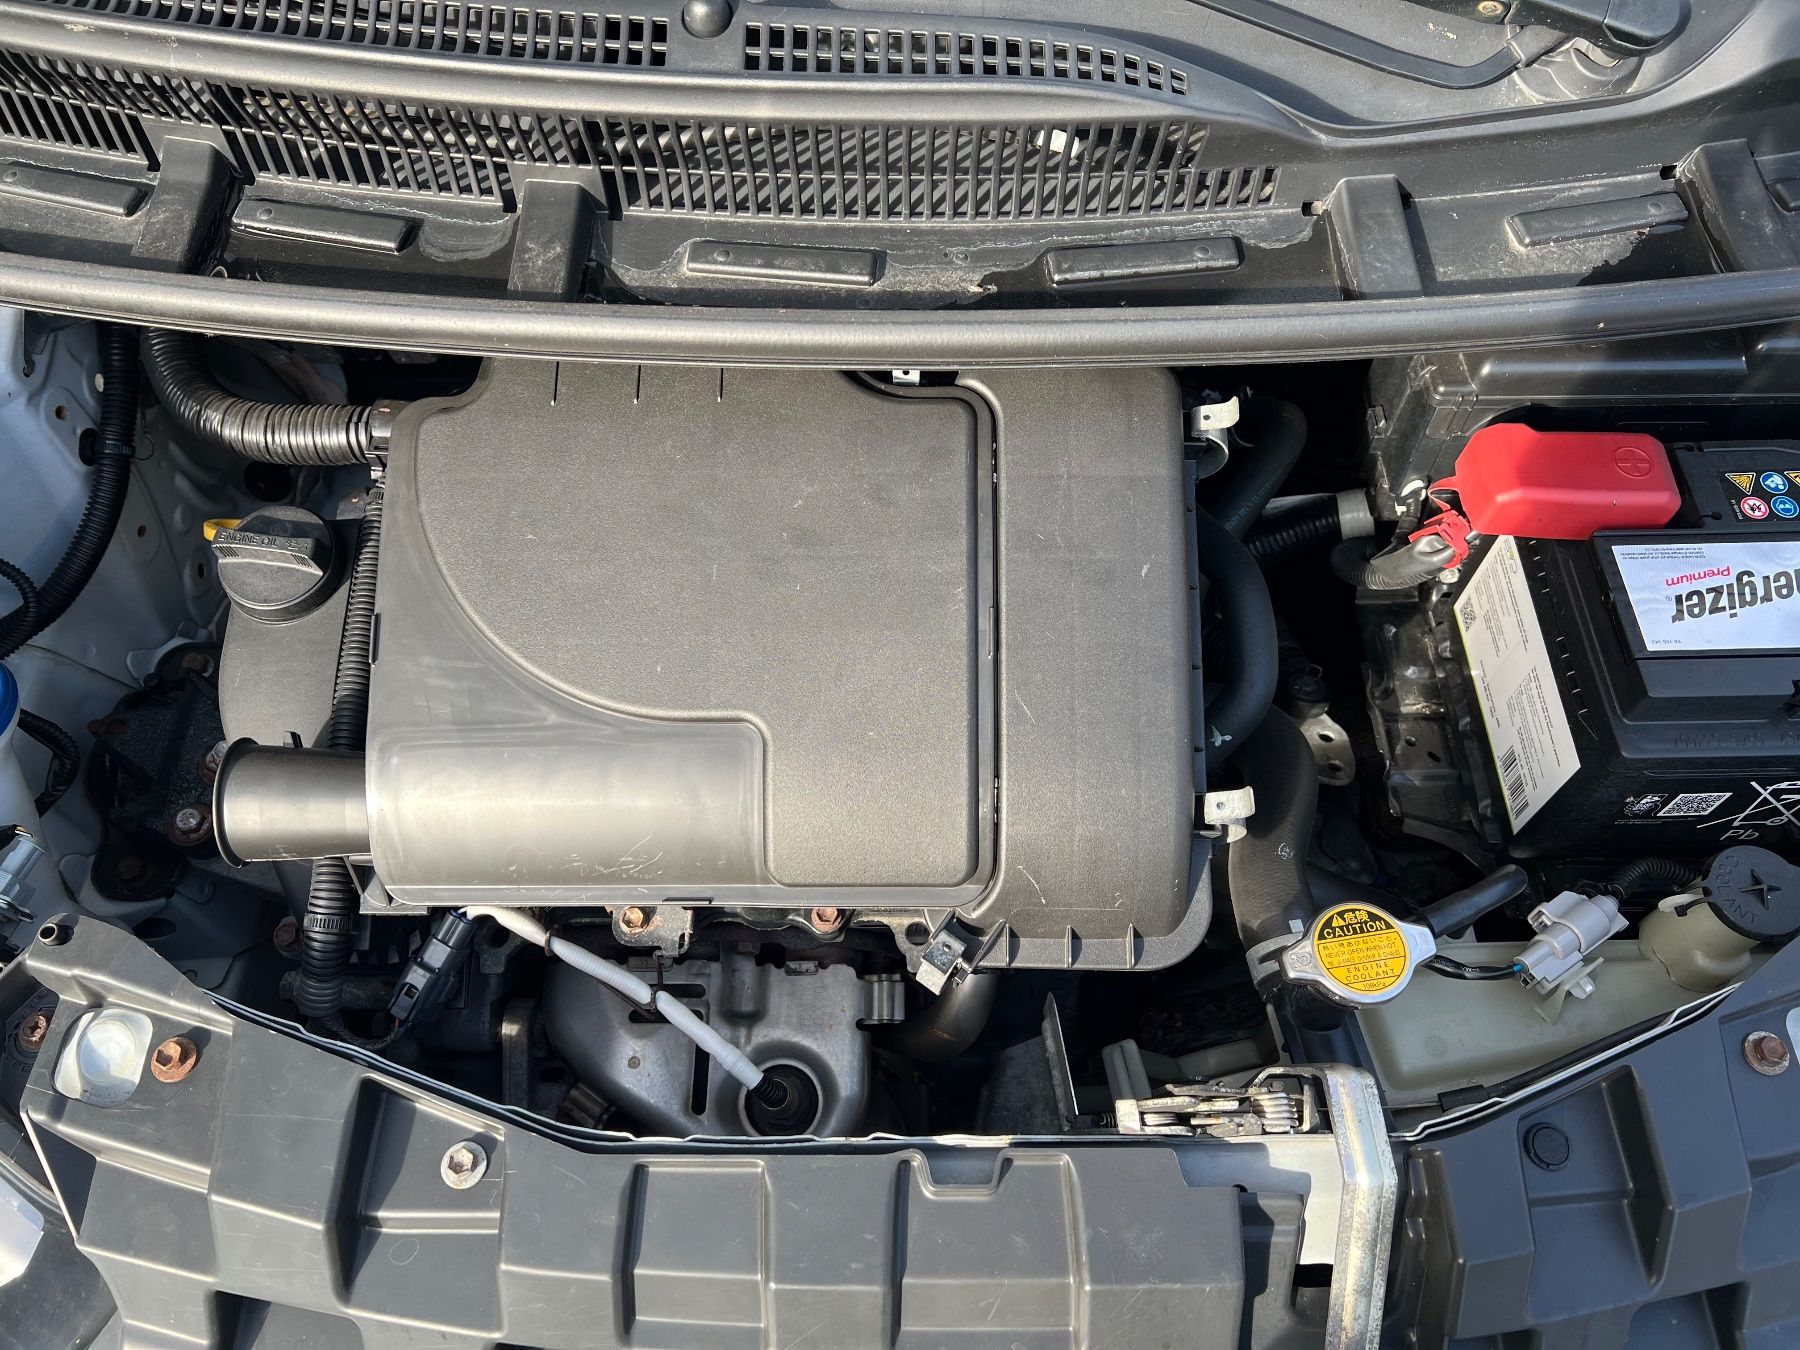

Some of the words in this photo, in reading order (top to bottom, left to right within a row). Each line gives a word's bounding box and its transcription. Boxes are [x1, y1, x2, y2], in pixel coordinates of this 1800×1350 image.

[218, 532, 260, 545] ENGINE
[261, 536, 279, 548] OIL
[1665, 566, 1731, 588] Premium
[1719, 829, 1760, 841] Pb
[1716, 855, 1760, 924] COOLANT
[1344, 910, 1370, 925] 危険
[1323, 920, 1387, 939] CAUTION
[1325, 951, 1346, 960] NEVER
[1347, 947, 1365, 956] OPEN
[1347, 961, 1390, 974] ENGINE
[1346, 968, 1395, 983] COOLANT
